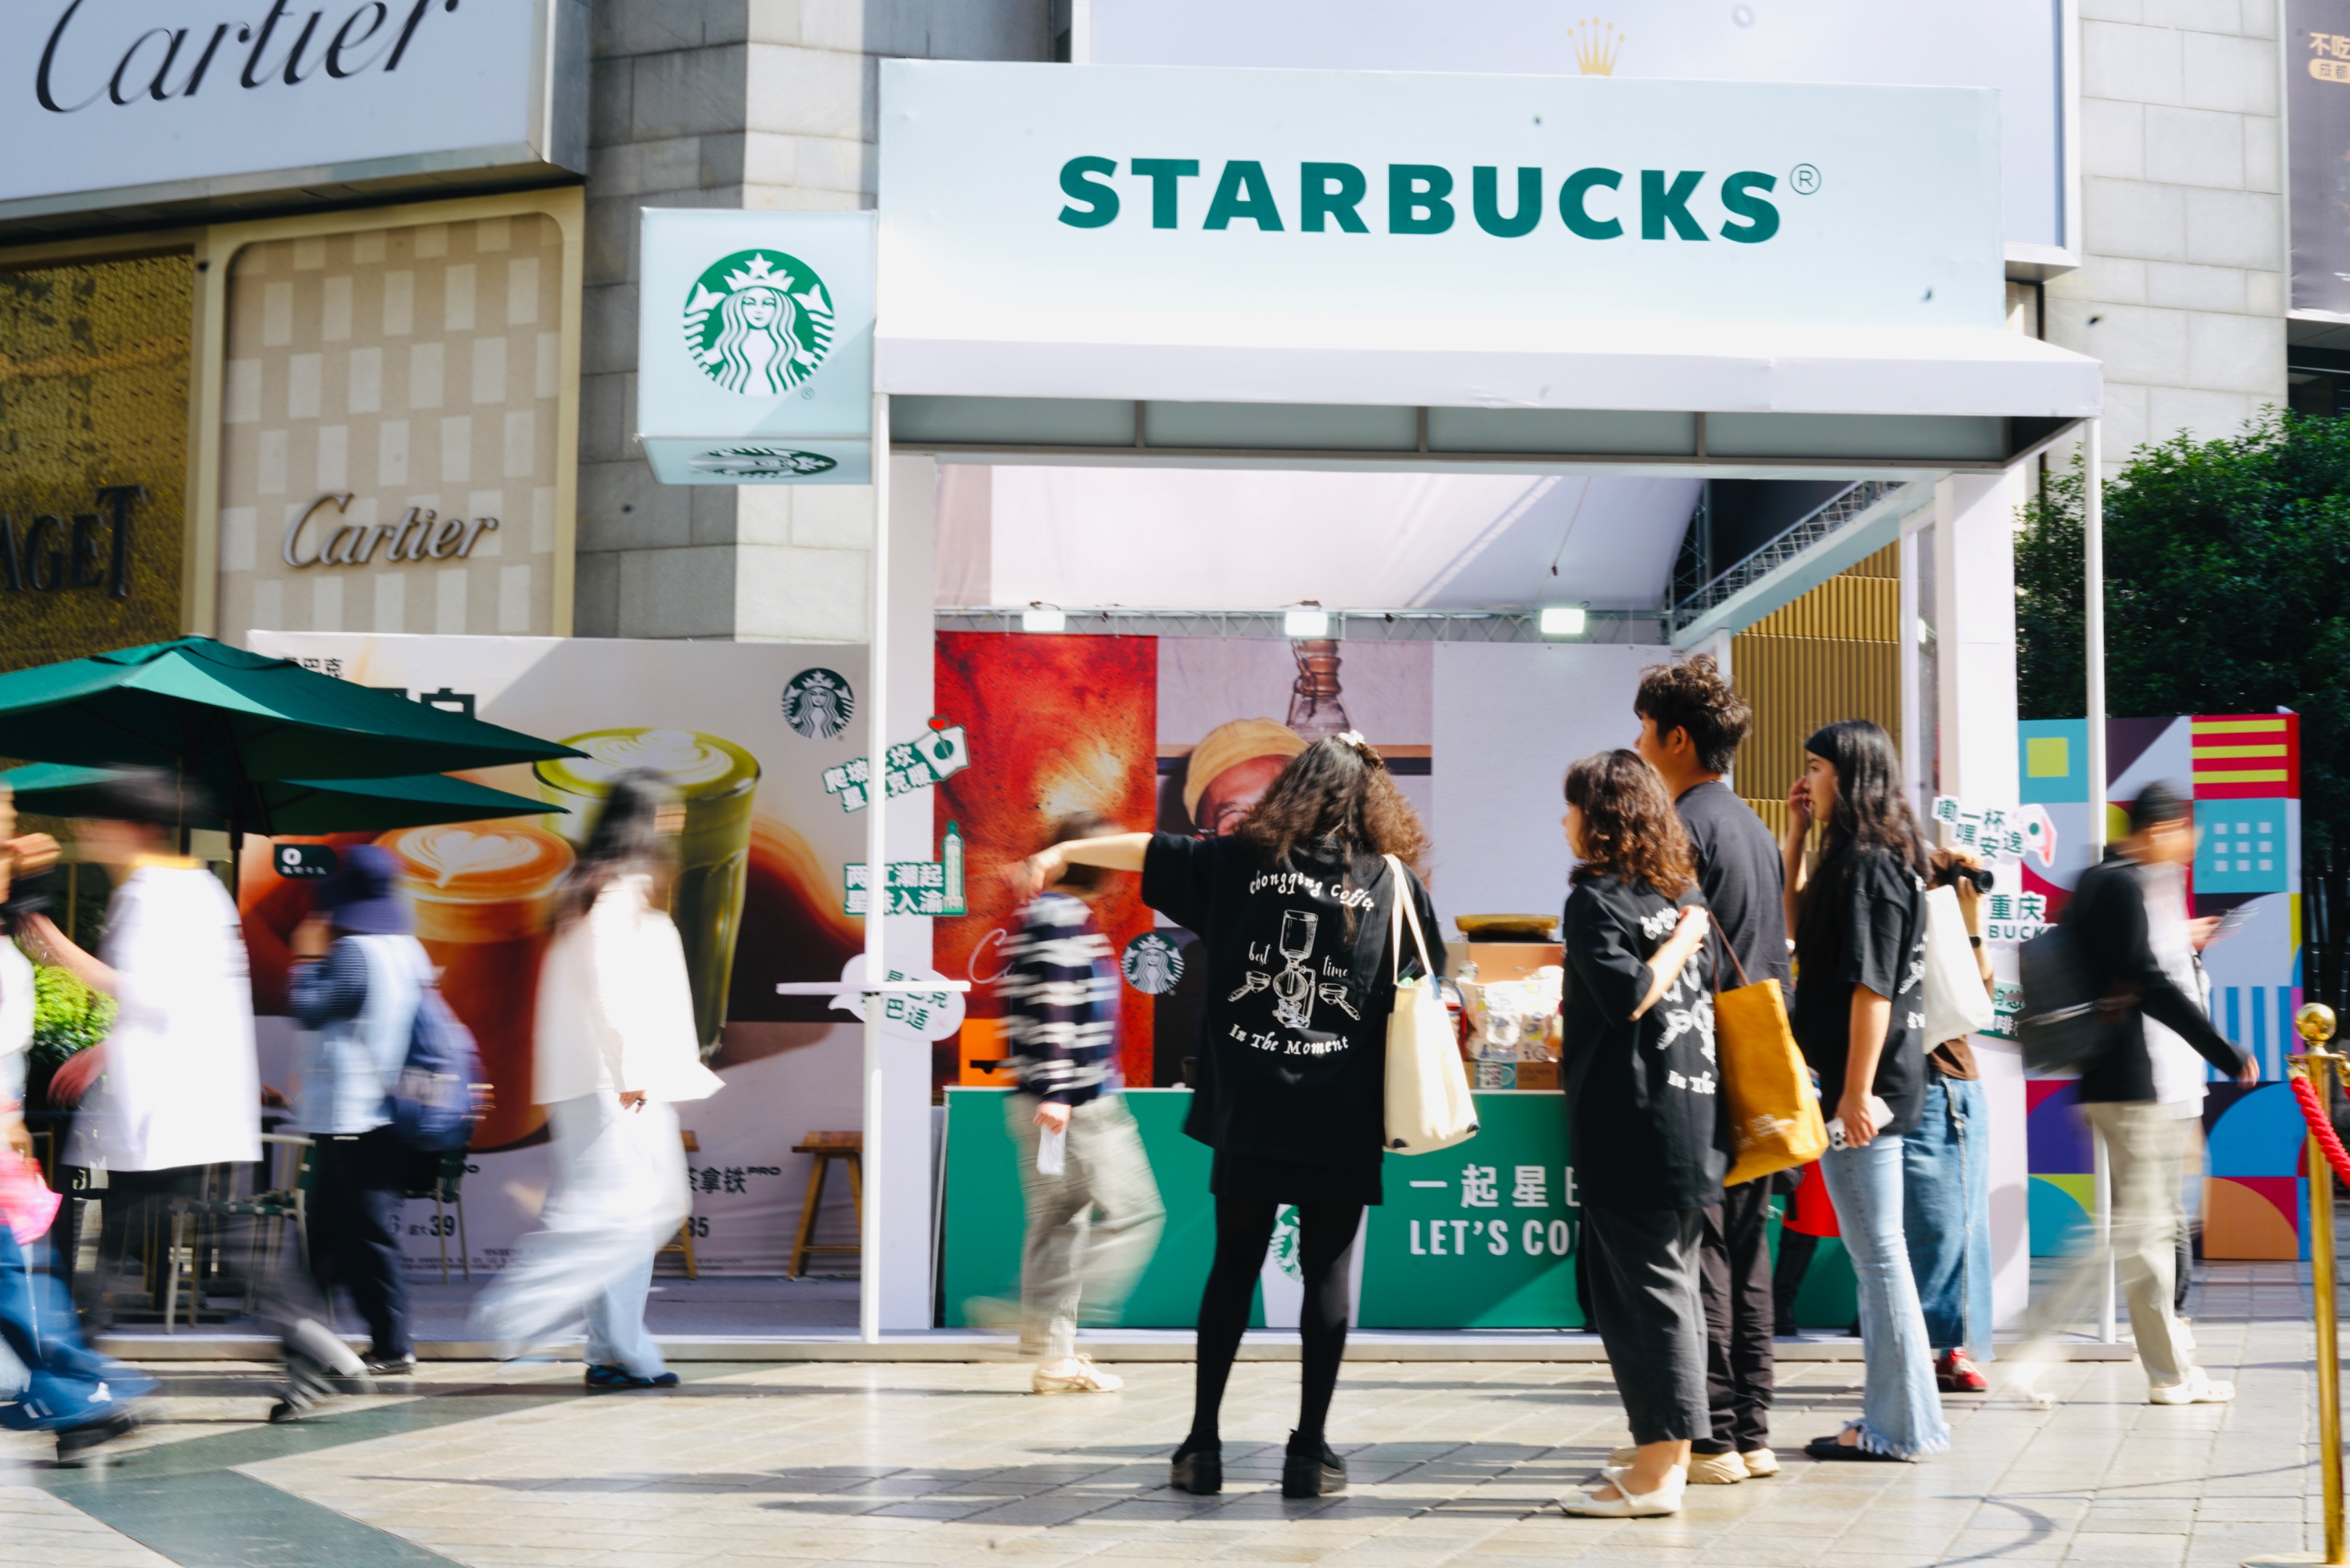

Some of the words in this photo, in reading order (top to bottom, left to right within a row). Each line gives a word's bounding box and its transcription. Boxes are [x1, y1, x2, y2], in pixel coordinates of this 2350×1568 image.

[1058, 155, 1782, 245] STARBUCKS
[283, 492, 499, 569] Cartier
[1988, 894, 2042, 920] 重庆
[1248, 942, 1271, 965] best
[1323, 955, 1348, 978] time
[1228, 1024, 1247, 1042] In
[1252, 1032, 1278, 1052] The
[1284, 1035, 1349, 1055] Moment
[1522, 1220, 1580, 1257] CO
